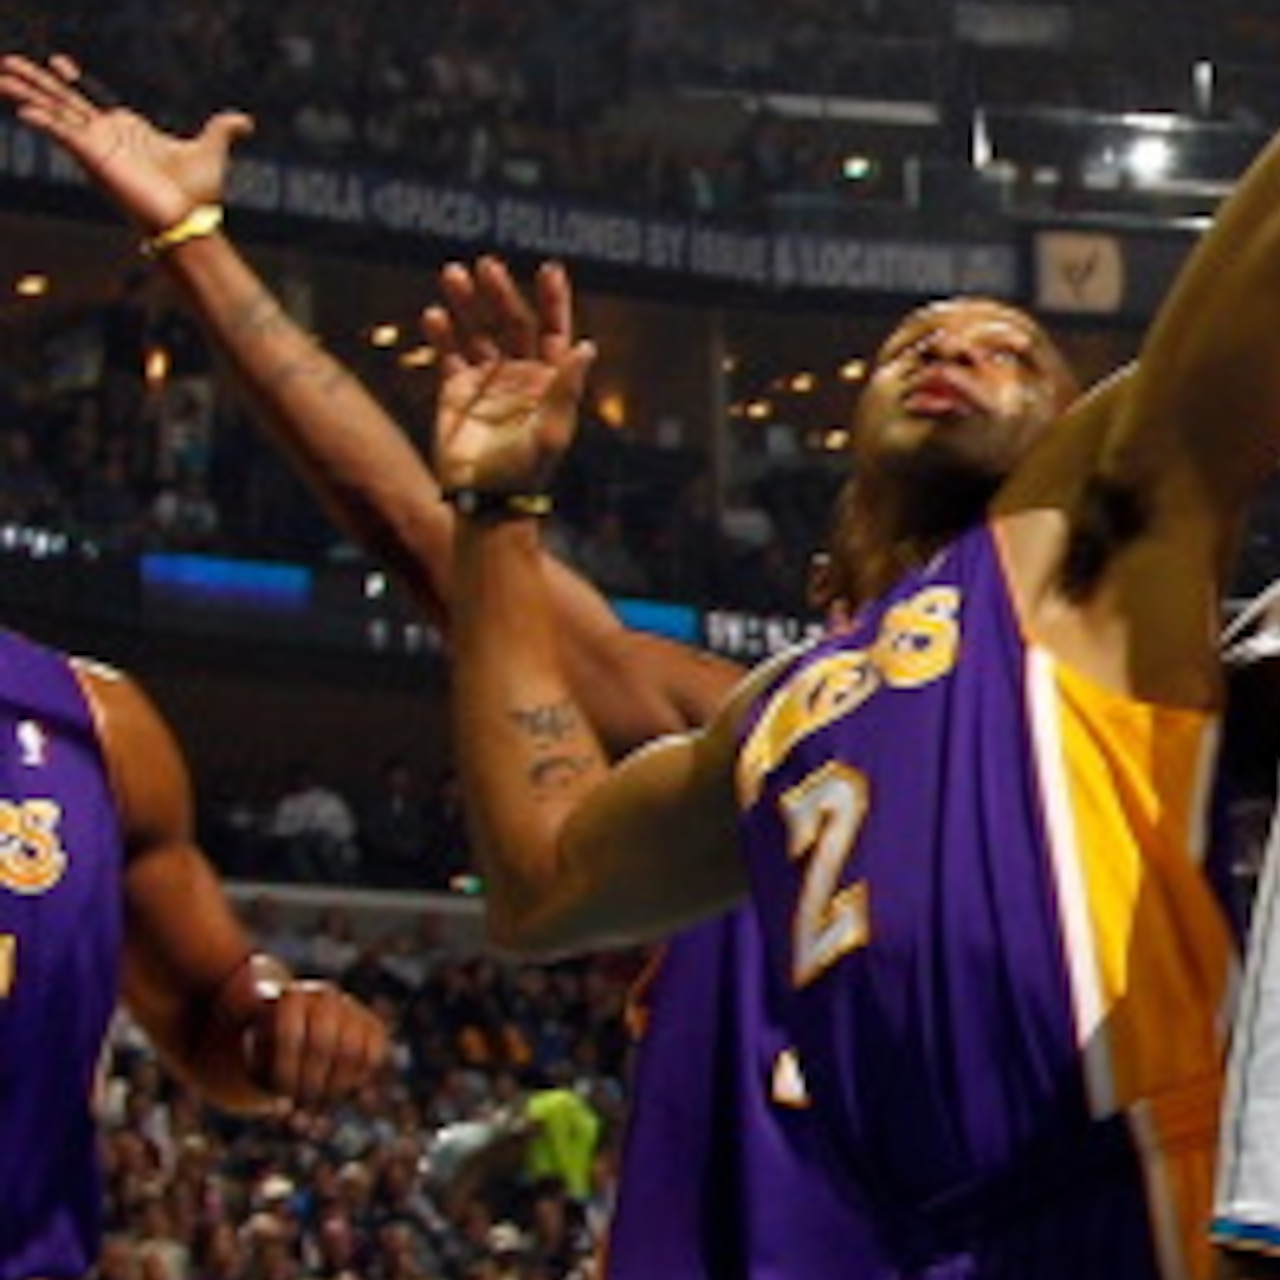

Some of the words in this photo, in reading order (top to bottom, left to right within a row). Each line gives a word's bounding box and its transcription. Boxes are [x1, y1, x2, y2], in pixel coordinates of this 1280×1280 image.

[496, 197, 641, 264] FOLLOWED
[645, 224, 686, 270] BY
[806, 239, 953, 292] LOCATION
[780, 760, 870, 988] 2
